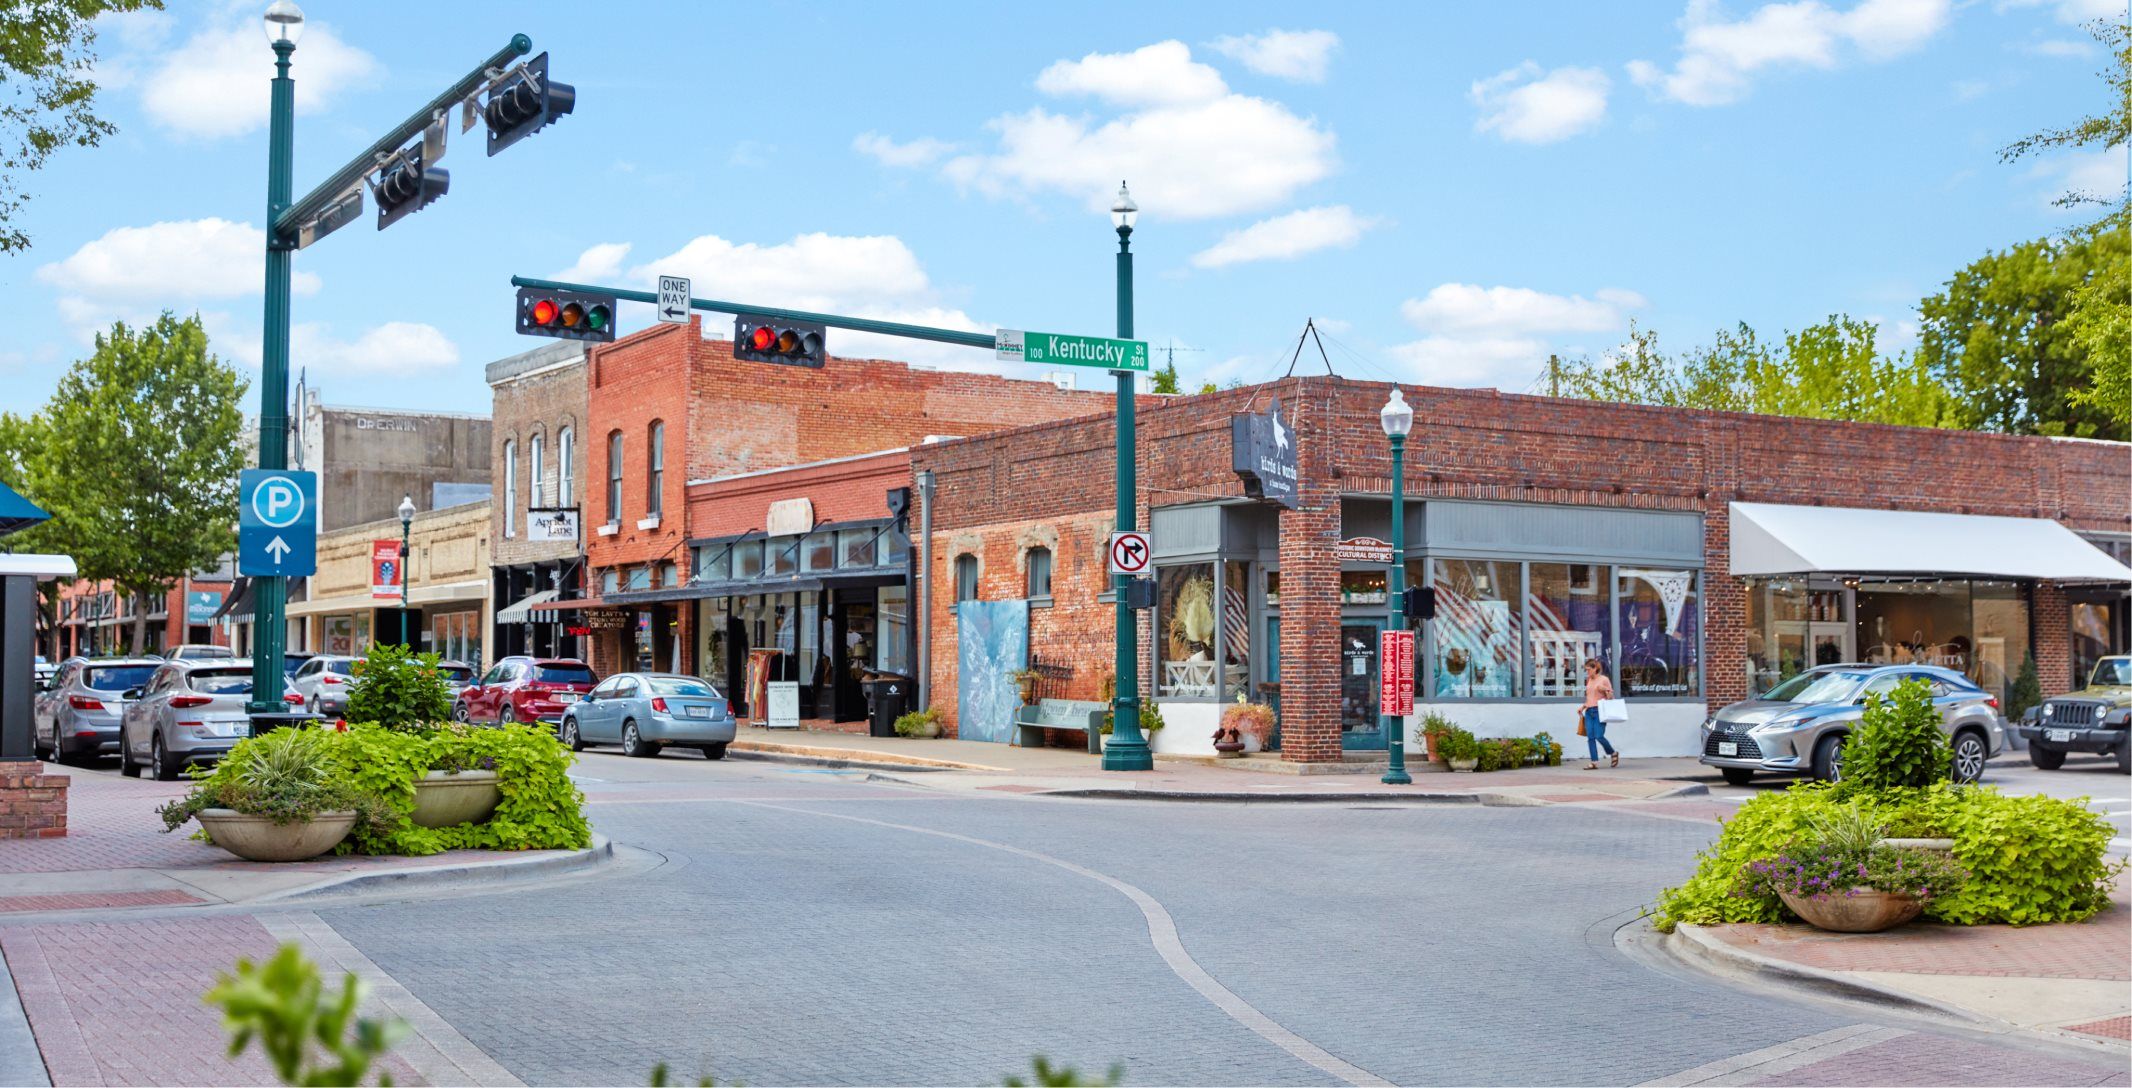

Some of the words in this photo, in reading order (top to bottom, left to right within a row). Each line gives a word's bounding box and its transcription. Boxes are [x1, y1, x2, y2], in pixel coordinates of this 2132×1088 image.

[663, 279, 686, 292] ONE
[662, 292, 686, 305] WAY
[1030, 347, 1043, 359] 100
[1049, 335, 1124, 367] Kentucky
[1135, 344, 1144, 356] St
[1130, 355, 1145, 367] 200
[376, 418, 417, 432] ERWIN
[268, 486, 293, 518] P
[548, 525, 573, 535] Lane
[1338, 550, 1367, 559] CULTURAL
[1631, 683, 1649, 691] words
